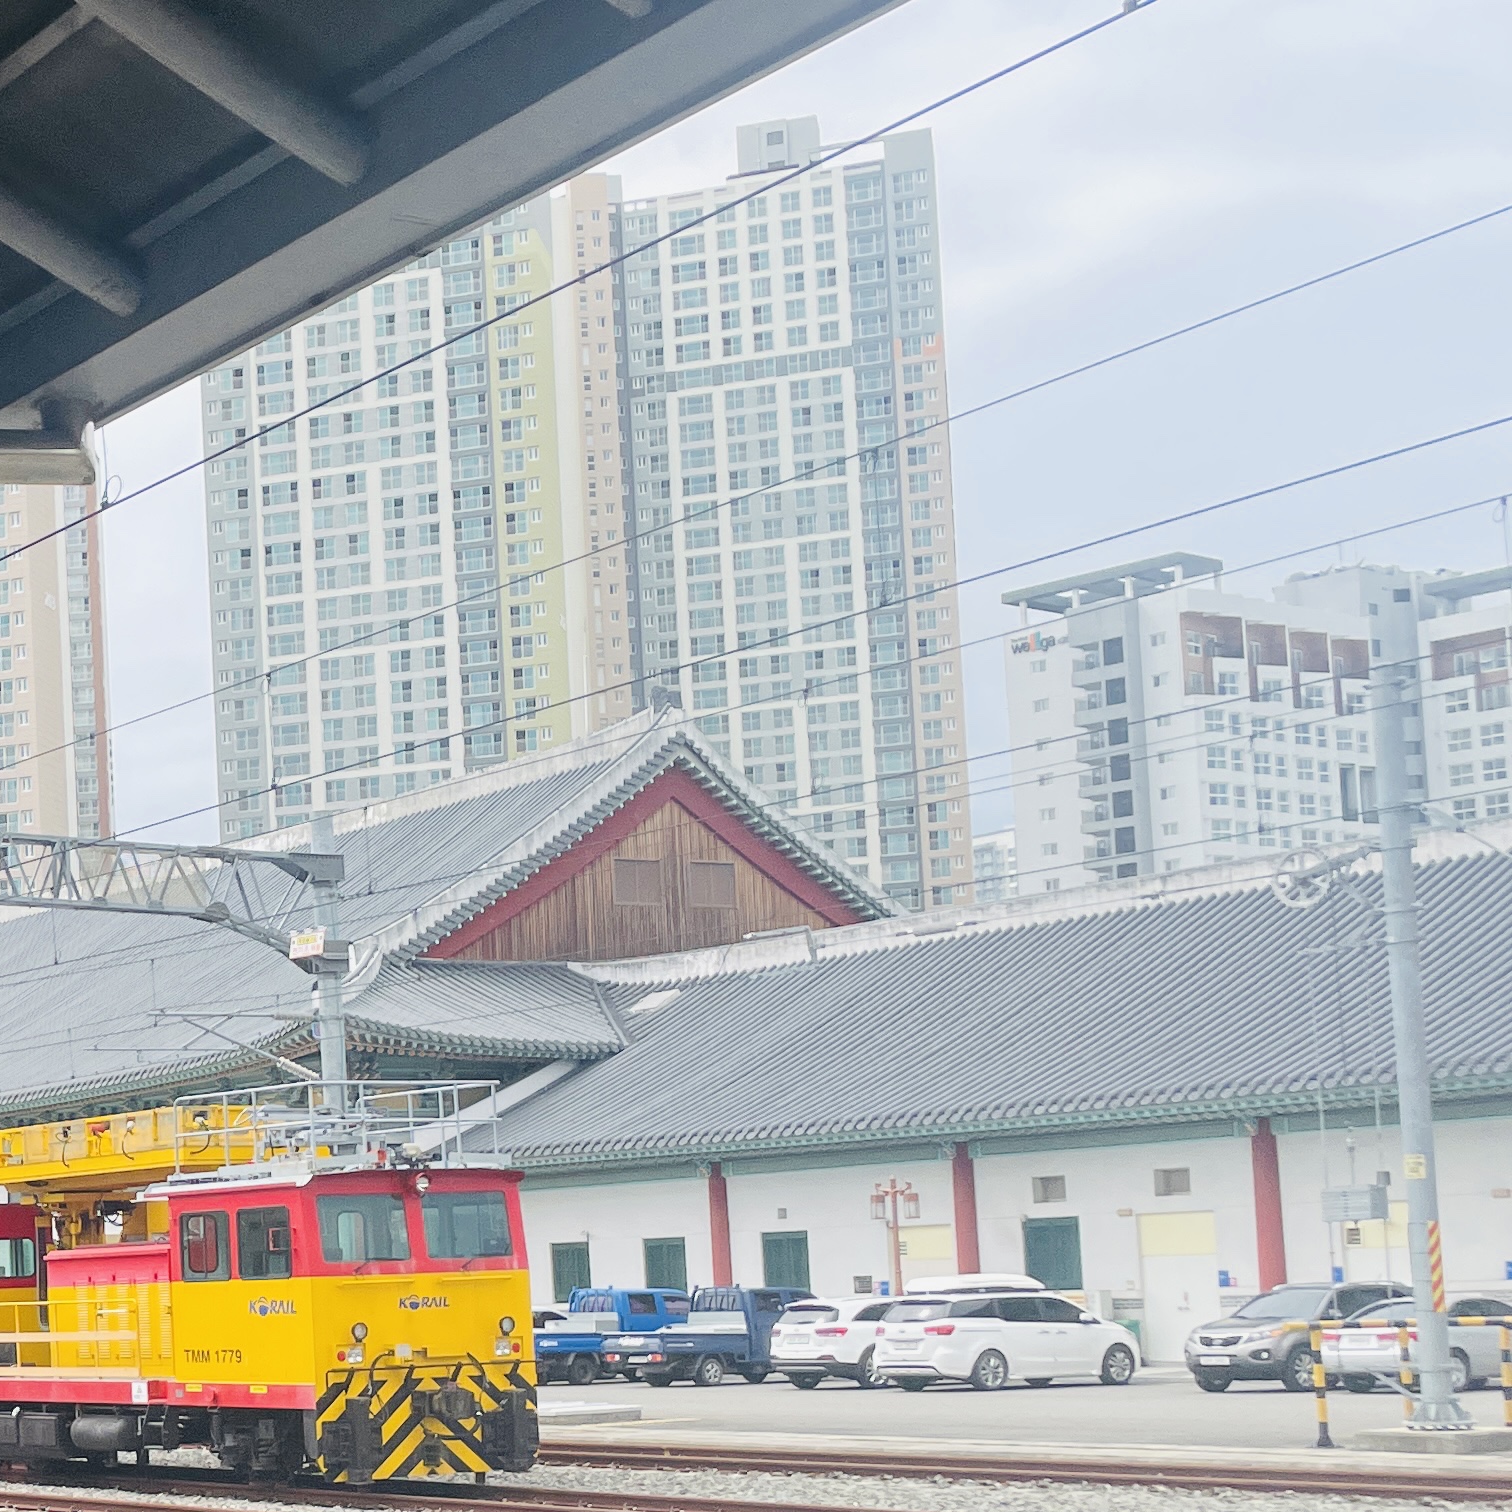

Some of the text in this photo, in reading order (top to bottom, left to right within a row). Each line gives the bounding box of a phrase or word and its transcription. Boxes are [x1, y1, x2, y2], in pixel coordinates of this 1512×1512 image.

[249, 1296, 297, 1316] KORAIL
[399, 1294, 450, 1310] KORAIL
[184, 1349, 242, 1364] TMM 1779
